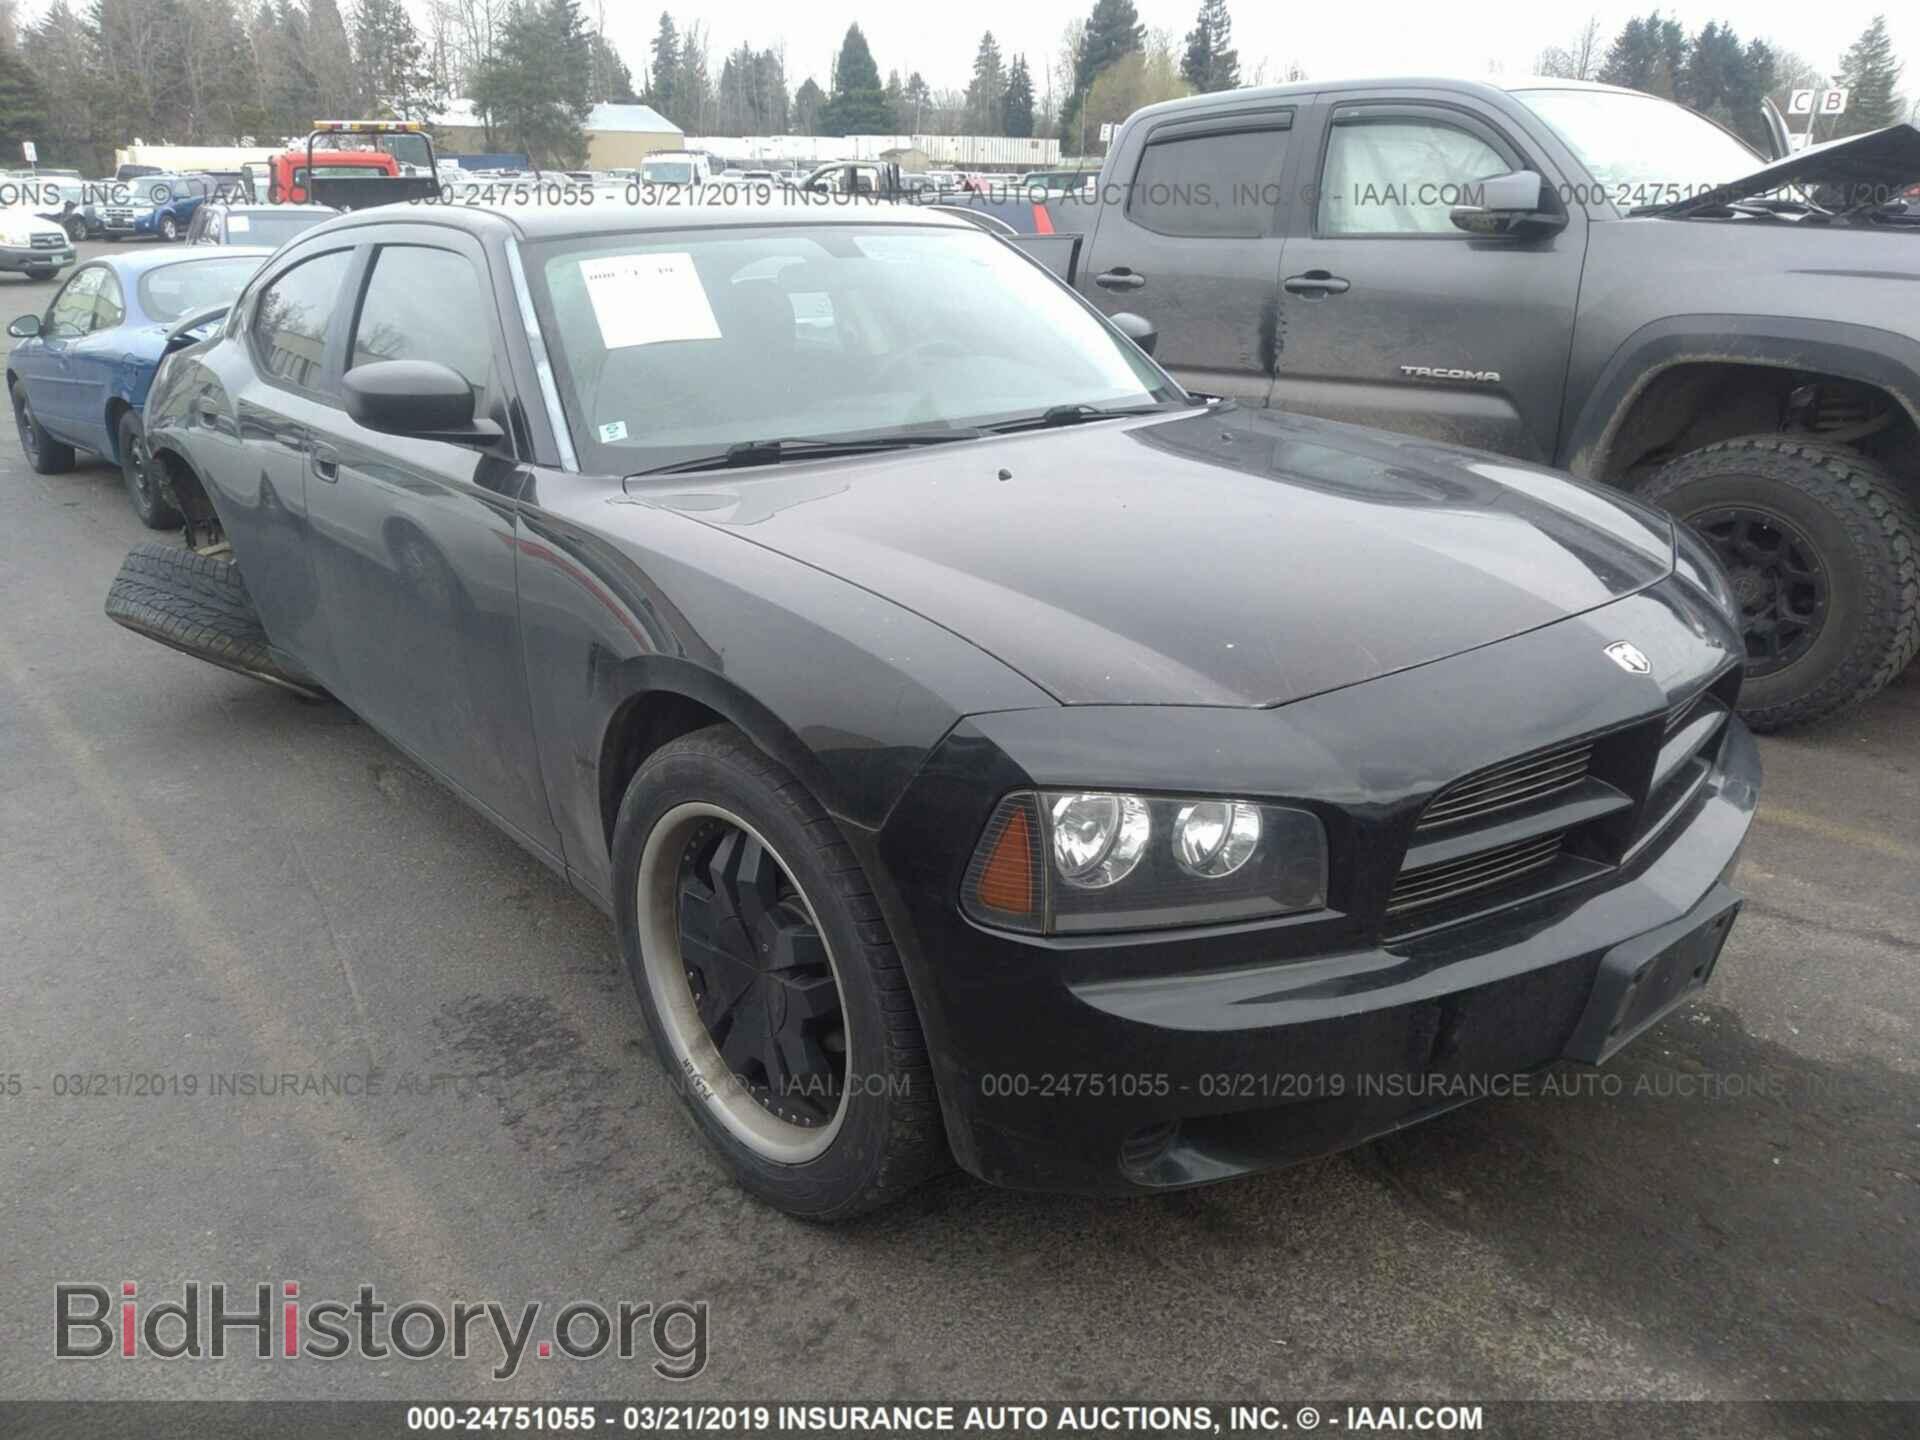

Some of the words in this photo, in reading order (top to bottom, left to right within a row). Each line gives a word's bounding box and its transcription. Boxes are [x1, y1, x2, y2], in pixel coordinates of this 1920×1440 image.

[1794, 92, 1810, 112] C
[1825, 92, 1843, 111] B
[1400, 365, 1500, 381] TACOMA
